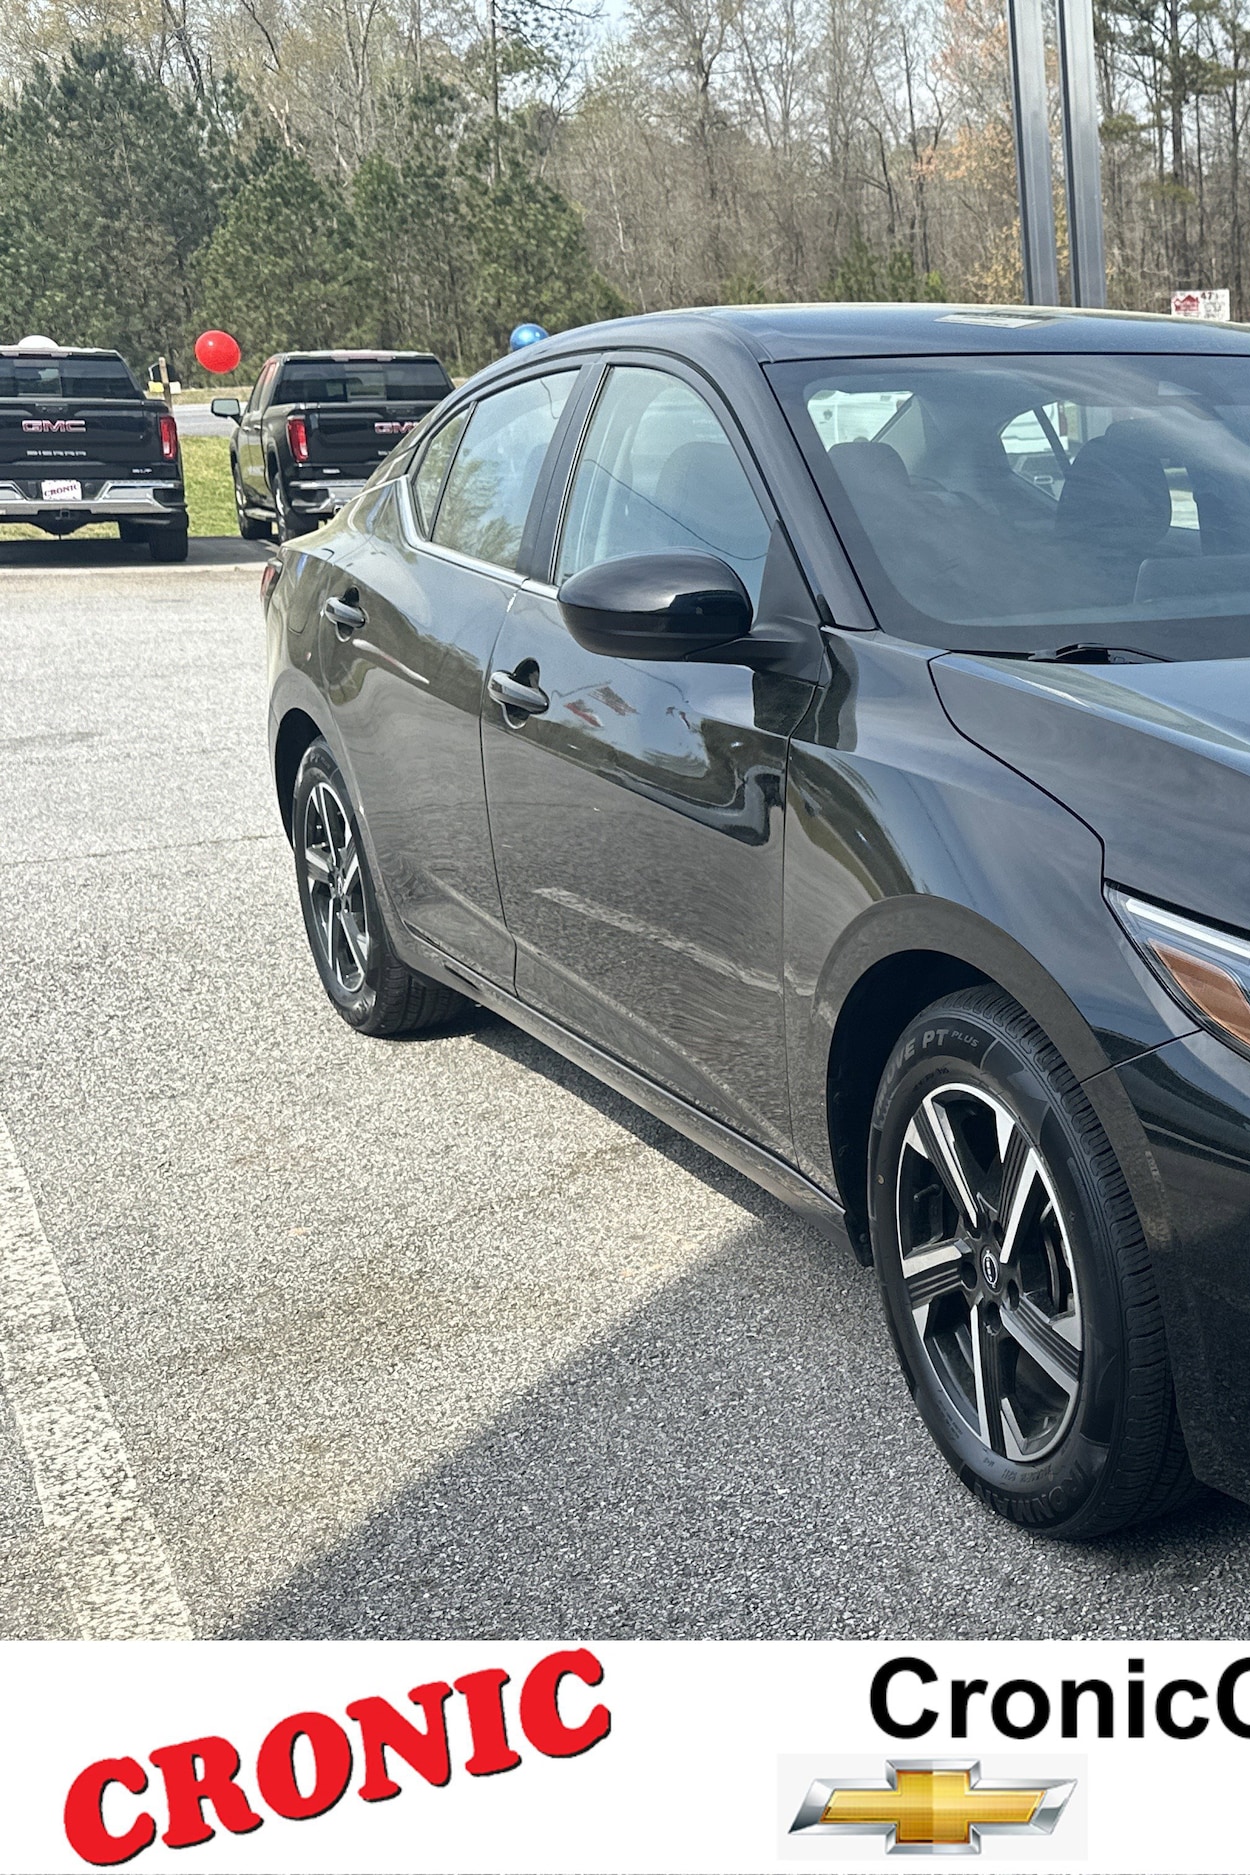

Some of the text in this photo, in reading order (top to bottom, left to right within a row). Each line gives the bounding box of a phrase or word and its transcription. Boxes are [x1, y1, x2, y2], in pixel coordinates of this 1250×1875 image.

[22, 420, 87, 432] GMC
[374, 422, 420, 434] GM
[922, 1029, 950, 1049] PT
[951, 1030, 980, 1048] PLUS
